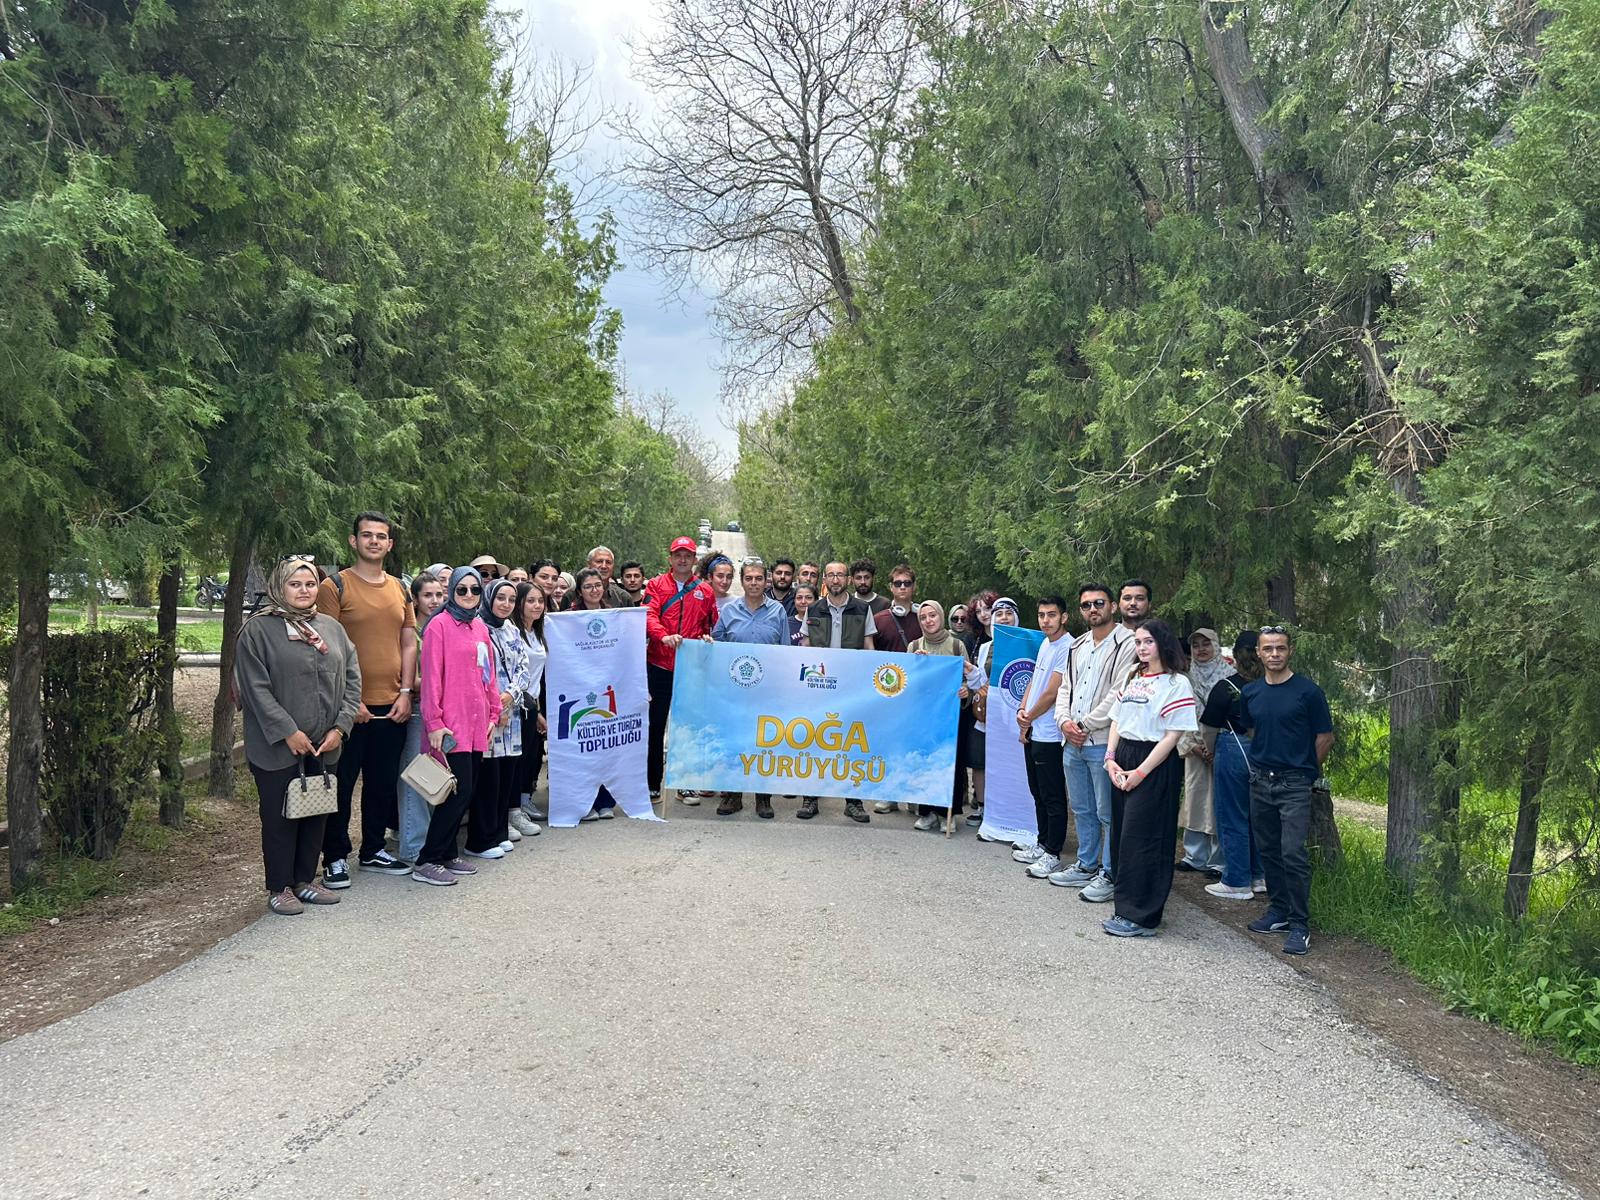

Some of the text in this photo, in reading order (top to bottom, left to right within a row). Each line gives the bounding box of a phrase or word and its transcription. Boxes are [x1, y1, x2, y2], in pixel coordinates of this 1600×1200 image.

[577, 718, 642, 740] KÜLTÜR VE TURİZM
[578, 730, 641, 753] TOPLULUĞU
[755, 712, 870, 753] DOĞA
[739, 750, 886, 787] YÜRÜYÜŞÜ
